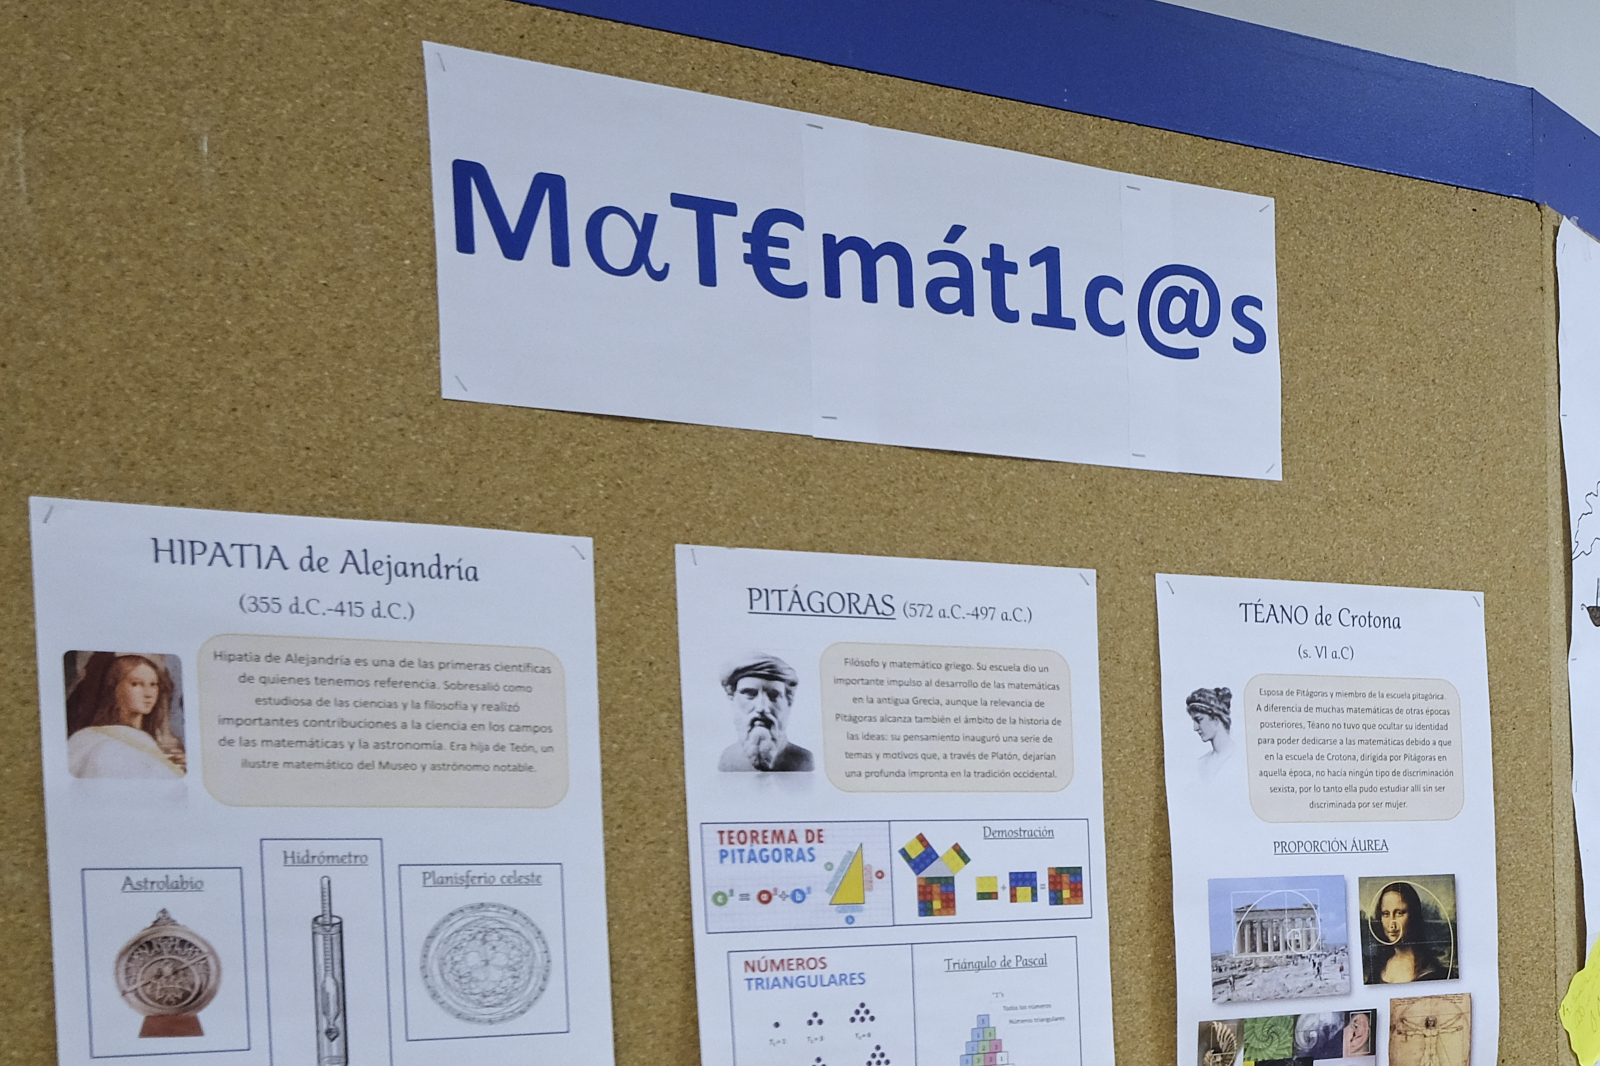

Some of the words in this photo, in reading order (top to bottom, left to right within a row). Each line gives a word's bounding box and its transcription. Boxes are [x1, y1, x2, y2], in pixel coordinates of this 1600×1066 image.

[150, 537, 290, 571] HIPATIA
[298, 544, 329, 573] de
[339, 548, 480, 586] Alejandría
[238, 593, 282, 614] (355
[288, 595, 365, 618] d.C.-415
[370, 599, 415, 621] d.C.)
[747, 586, 896, 619] PITÁGORAS
[902, 602, 933, 618] (572
[938, 604, 996, 619] a.C.-497
[999, 605, 1033, 622] a.C.)
[1238, 598, 1309, 625] TÉANO
[1314, 604, 1332, 627] de
[1338, 607, 1402, 629] Crotona
[1297, 643, 1311, 660] (s.
[1314, 645, 1327, 659] VI
[1331, 645, 1354, 661] a.C)
[212, 650, 261, 664] Hipatia
[263, 652, 282, 664] de
[284, 652, 351, 667] Alejandría
[353, 658, 369, 667] es
[371, 658, 396, 668] una
[398, 657, 415, 669] de
[417, 657, 435, 670] las
[437, 659, 492, 672] primeras
[493, 661, 552, 674] científicas
[843, 657, 880, 668] Filósofo
[888, 659, 943, 670] matemático
[976, 661, 987, 671] Su
[988, 662, 1021, 672] escuela
[1022, 663, 1036, 673] dio
[237, 672, 255, 684] de
[258, 673, 311, 686] quienes
[313, 675, 371, 688] tenemos
[442, 680, 501, 692] Sobresalió
[502, 684, 533, 693] como
[833, 676, 885, 686] importante
[886, 677, 923, 688] impulso
[924, 678, 933, 687] al
[934, 678, 979, 689] desarrollo
[980, 679, 992, 689] de
[993, 680, 1006, 689] las
[1007, 681, 1060, 691] matemáticas
[851, 696, 864, 704] en
[865, 695, 875, 704] la
[876, 695, 910, 707] antigua
[944, 698, 978, 708] aunque
[979, 697, 988, 707] la
[989, 698, 1033, 708] relevancia
[1034, 699, 1045, 708] de
[1258, 687, 1284, 697] Esposa
[1285, 688, 1295, 697] de
[1295, 688, 1329, 699] Pitágoras
[1335, 689, 1367, 699] miembro
[1367, 690, 1377, 699] de
[1377, 690, 1385, 699] la
[1385, 691, 1411, 700] escuela
[254, 695, 313, 707] estudiosa
[314, 696, 331, 708] de
[333, 697, 350, 708] las
[352, 698, 399, 709] ciencias
[410, 699, 421, 710] la
[423, 699, 469, 711] filosofía
[480, 701, 520, 713] realizó
[1263, 703, 1302, 713] diferencia
[1303, 703, 1314, 713] de
[1315, 705, 1345, 714] muchas
[1346, 705, 1394, 715] matemáticas
[1394, 706, 1404, 715] de
[1405, 707, 1424, 715] otras
[1425, 706, 1450, 717] épocas
[217, 714, 300, 728] importantes
[302, 717, 398, 730] contribuciones
[410, 719, 422, 730] la
[424, 719, 468, 731] ciencia
[469, 723, 486, 732] en
[488, 720, 506, 732] los
[508, 723, 553, 734] campos
[834, 712, 878, 724] Pitágoras
[879, 713, 913, 723] alcanza
[914, 714, 951, 724] también
[952, 715, 962, 724] el
[963, 714, 994, 725] ámbito
[995, 716, 1007, 725] de
[1008, 716, 1017, 725] la
[1018, 716, 1050, 726] historia
[1051, 716, 1062, 726] de
[1306, 720, 1330, 729] Téano
[1331, 722, 1342, 730] no
[1343, 722, 1361, 730] tuvo
[1361, 723, 1376, 731] que
[1377, 721, 1403, 730] ocultar
[1404, 723, 1413, 731] su
[1414, 721, 1449, 731] identidad
[1257, 737, 1275, 746] para
[1276, 735, 1300, 746] poder
[1301, 736, 1338, 746] dedicarse
[1345, 736, 1356, 746] las
[1357, 737, 1405, 746] matemáticas
[1405, 737, 1431, 746] debido
[1437, 739, 1452, 748] que
[716, 828, 799, 847] TEOREMA
[804, 828, 824, 844] DE
[982, 825, 1055, 840] Demostración
[1273, 836, 1347, 855] PROPORCIÓN
[1350, 836, 1389, 854] ÁUREA
[282, 849, 369, 867] Hidrómetro
[718, 847, 816, 864] PITÁGORAS
[121, 875, 204, 893] Astrolabio
[421, 869, 496, 888] Planisferio
[499, 869, 542, 887] celeste
[743, 955, 828, 973] NÚMEROS
[943, 955, 997, 973] Triángulo
[999, 954, 1012, 970] de
[1014, 952, 1048, 969] Pascal
[743, 971, 866, 991] TRIANGULARES
